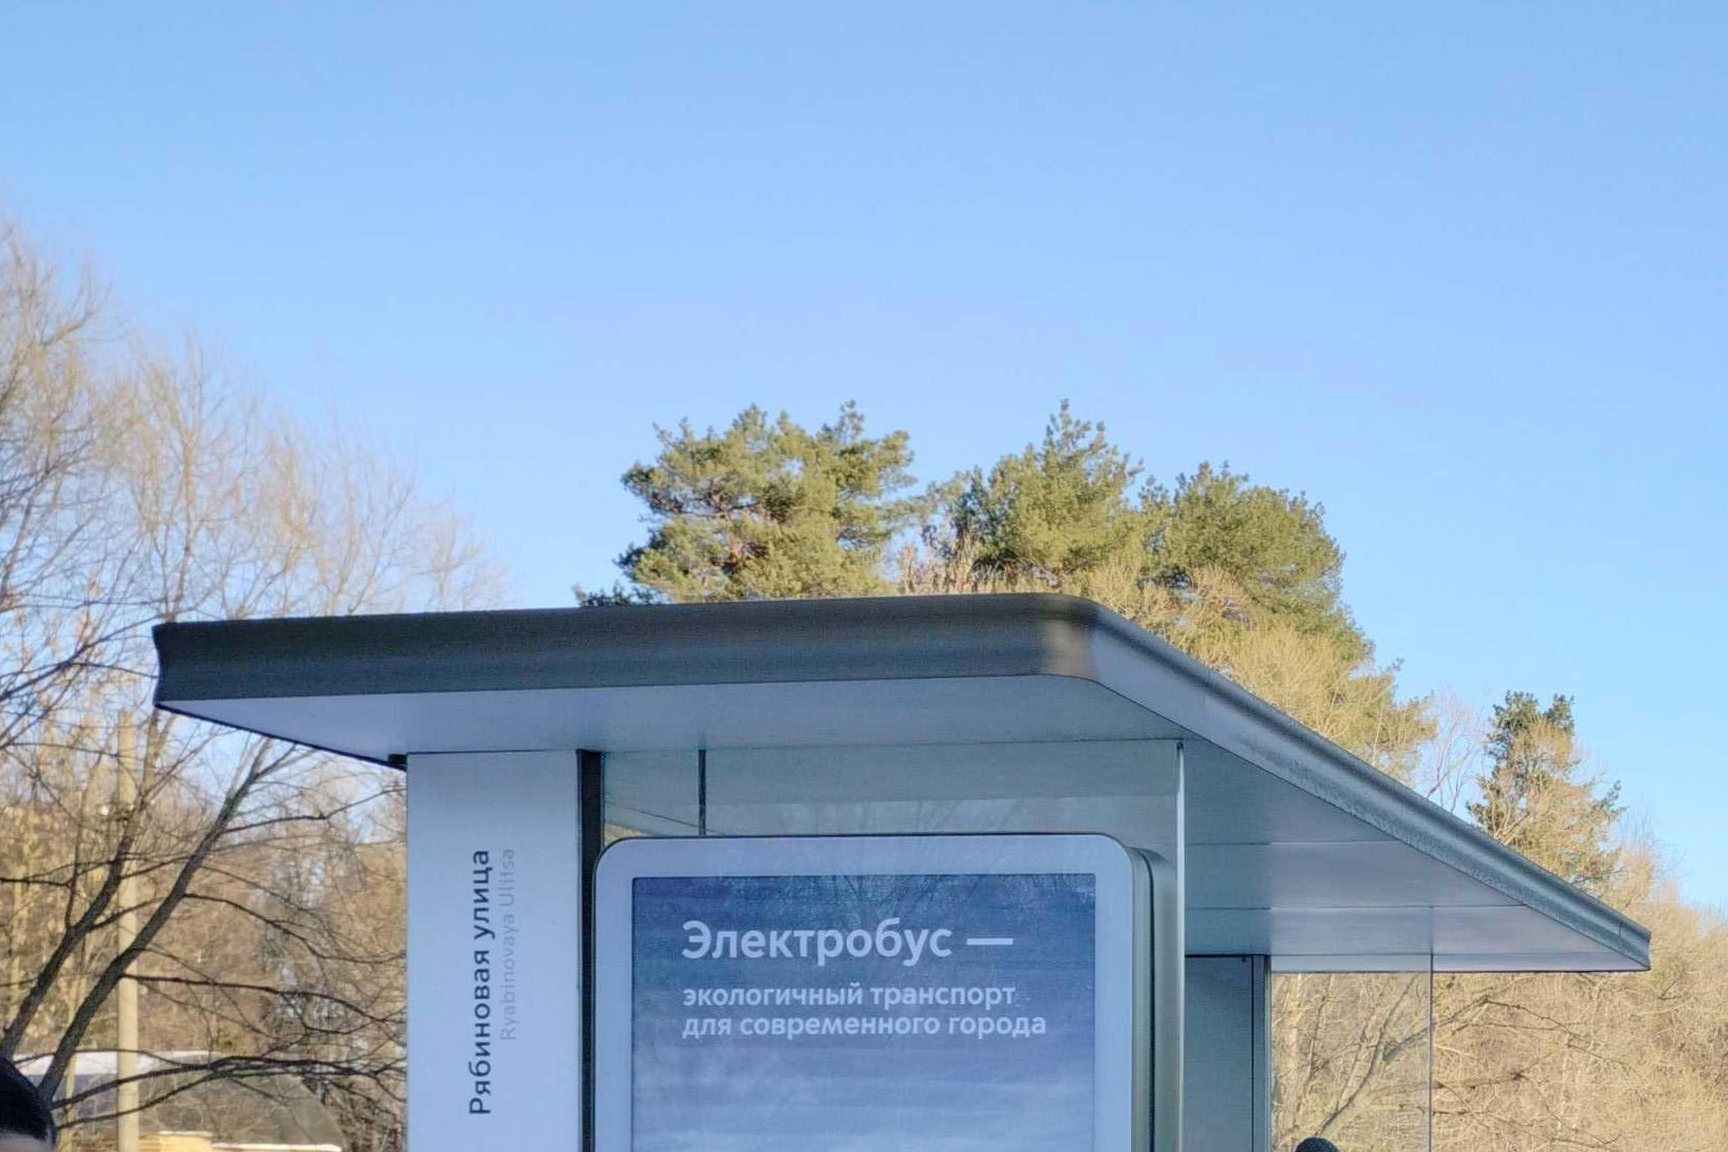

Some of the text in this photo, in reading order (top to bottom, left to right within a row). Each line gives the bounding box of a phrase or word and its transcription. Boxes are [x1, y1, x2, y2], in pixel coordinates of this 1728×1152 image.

[499, 849, 520, 1040] Ryabinovaya Ulitsa
[681, 917, 953, 967] Электробус
[469, 849, 496, 1115] Рябиновая улица
[682, 983, 1017, 1011] экологичный транспорт
[682, 1015, 1047, 1040] для современного города
